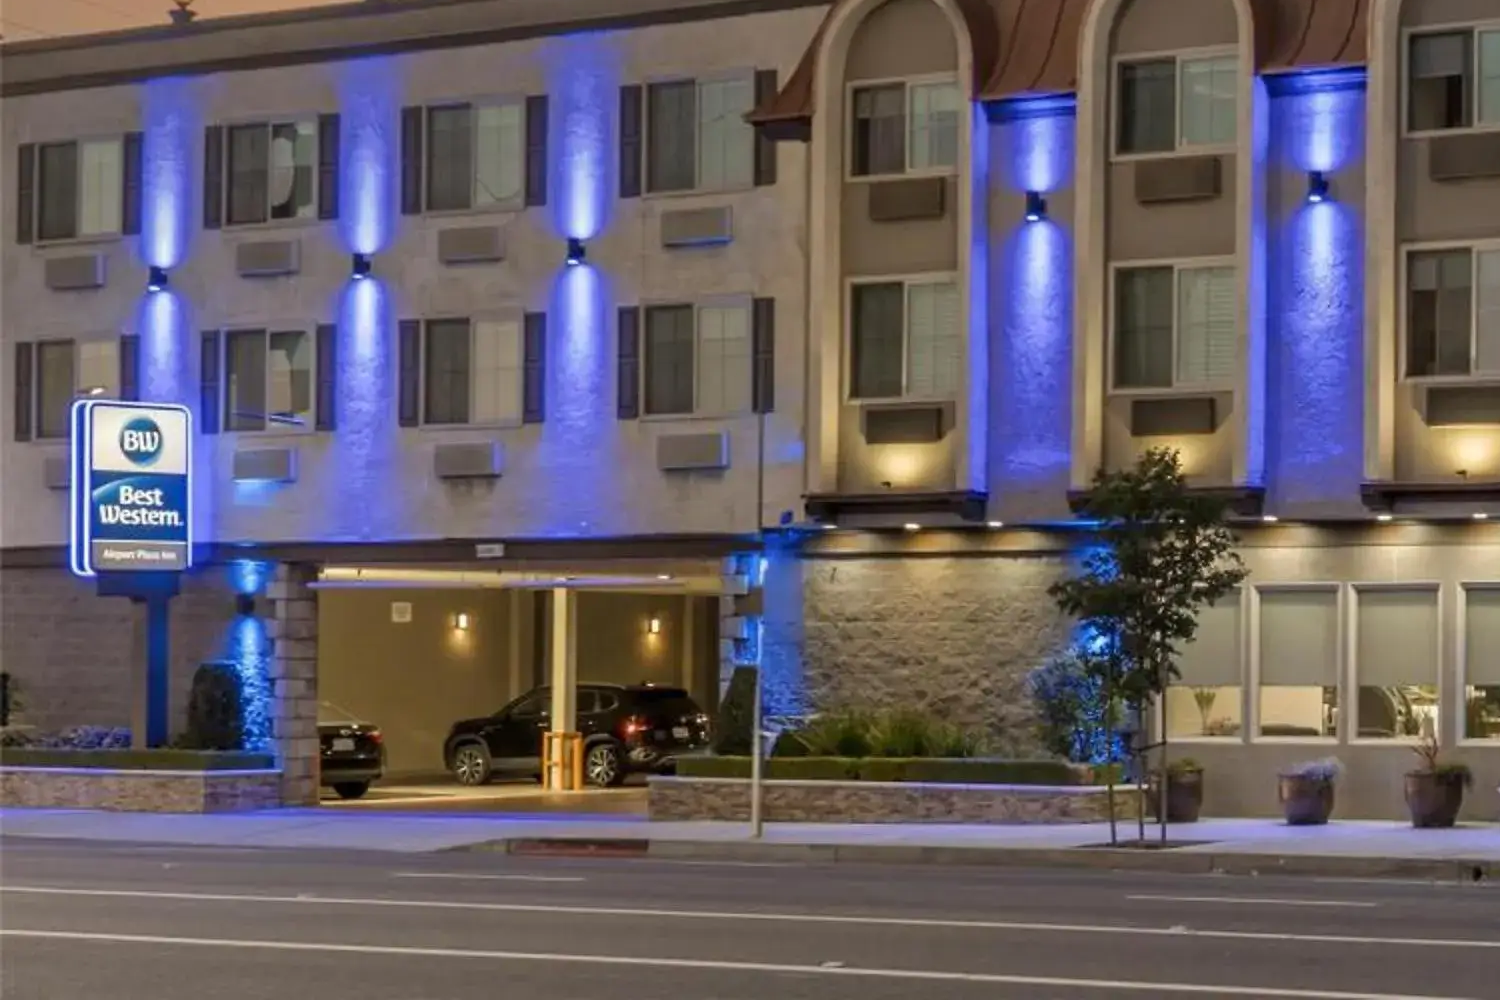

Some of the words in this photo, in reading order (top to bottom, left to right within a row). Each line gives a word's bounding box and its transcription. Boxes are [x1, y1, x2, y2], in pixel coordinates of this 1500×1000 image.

[123, 430, 159, 452] BW
[119, 486, 163, 505] Best
[99, 504, 179, 526] Western
